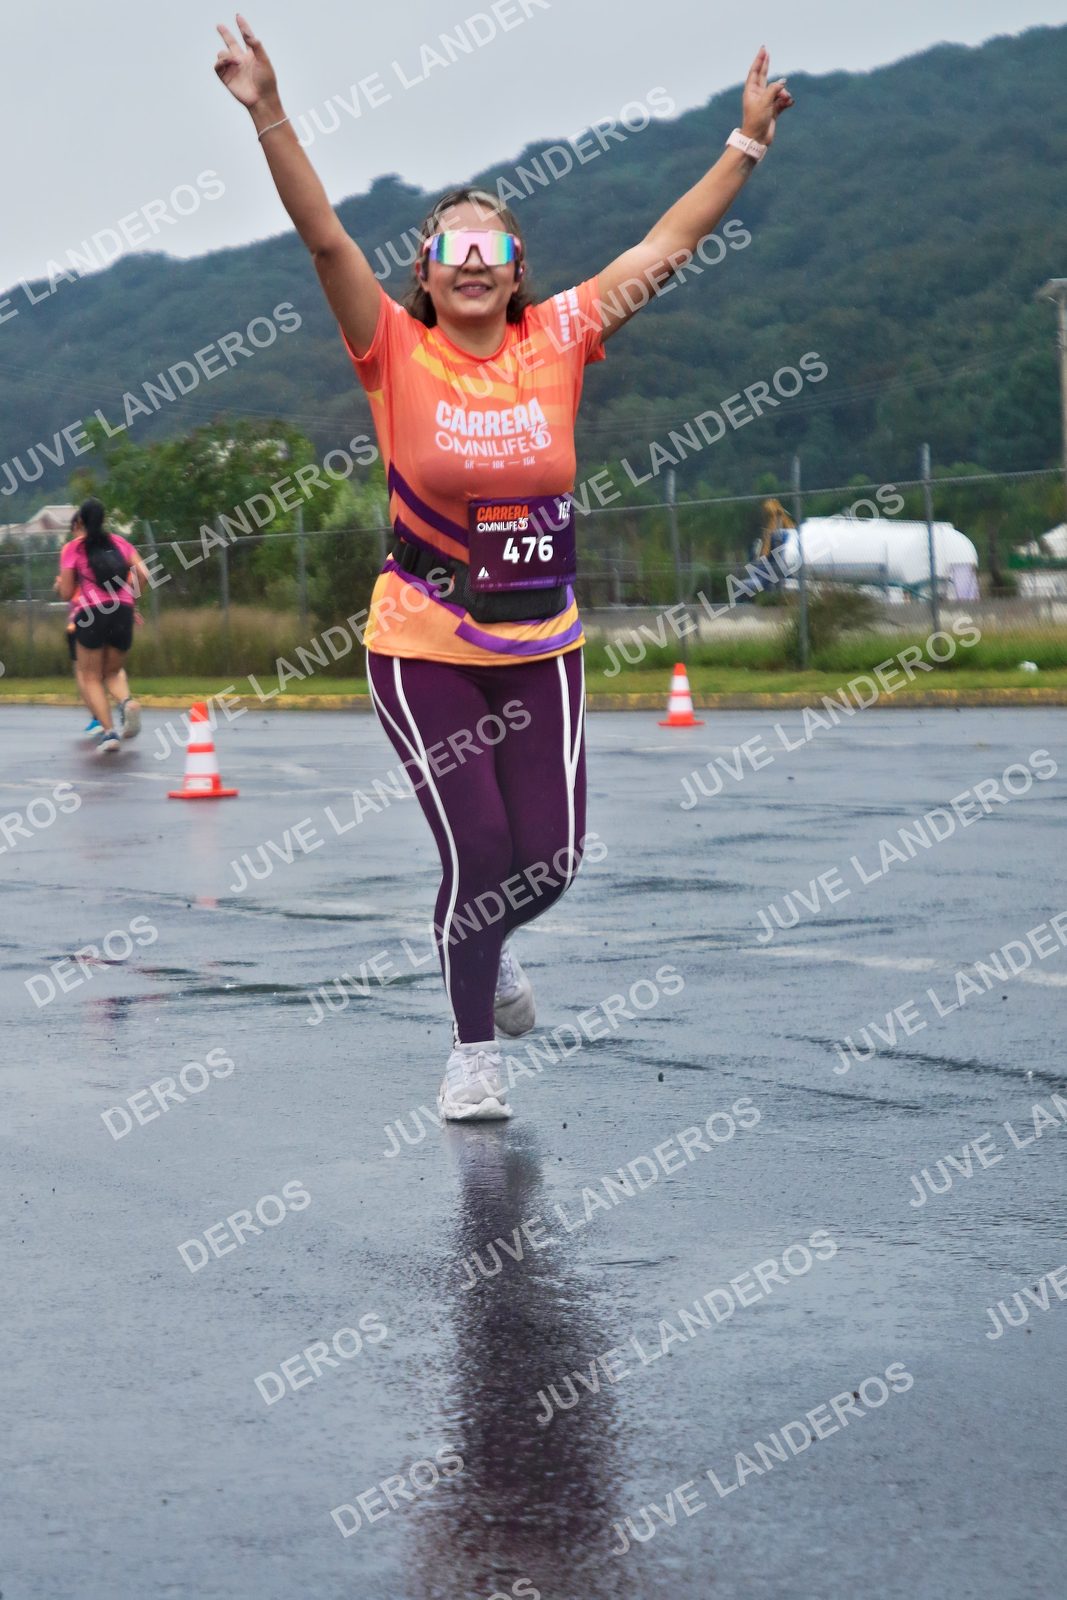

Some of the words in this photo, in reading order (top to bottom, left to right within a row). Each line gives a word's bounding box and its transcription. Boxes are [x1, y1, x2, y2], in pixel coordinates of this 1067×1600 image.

[436, 397, 545, 436] CARRERA
[435, 431, 529, 456] OMNILIFE
[477, 504, 529, 522] CARRERA
[477, 520, 518, 532] OMNILIFE
[502, 535, 554, 564] 476
